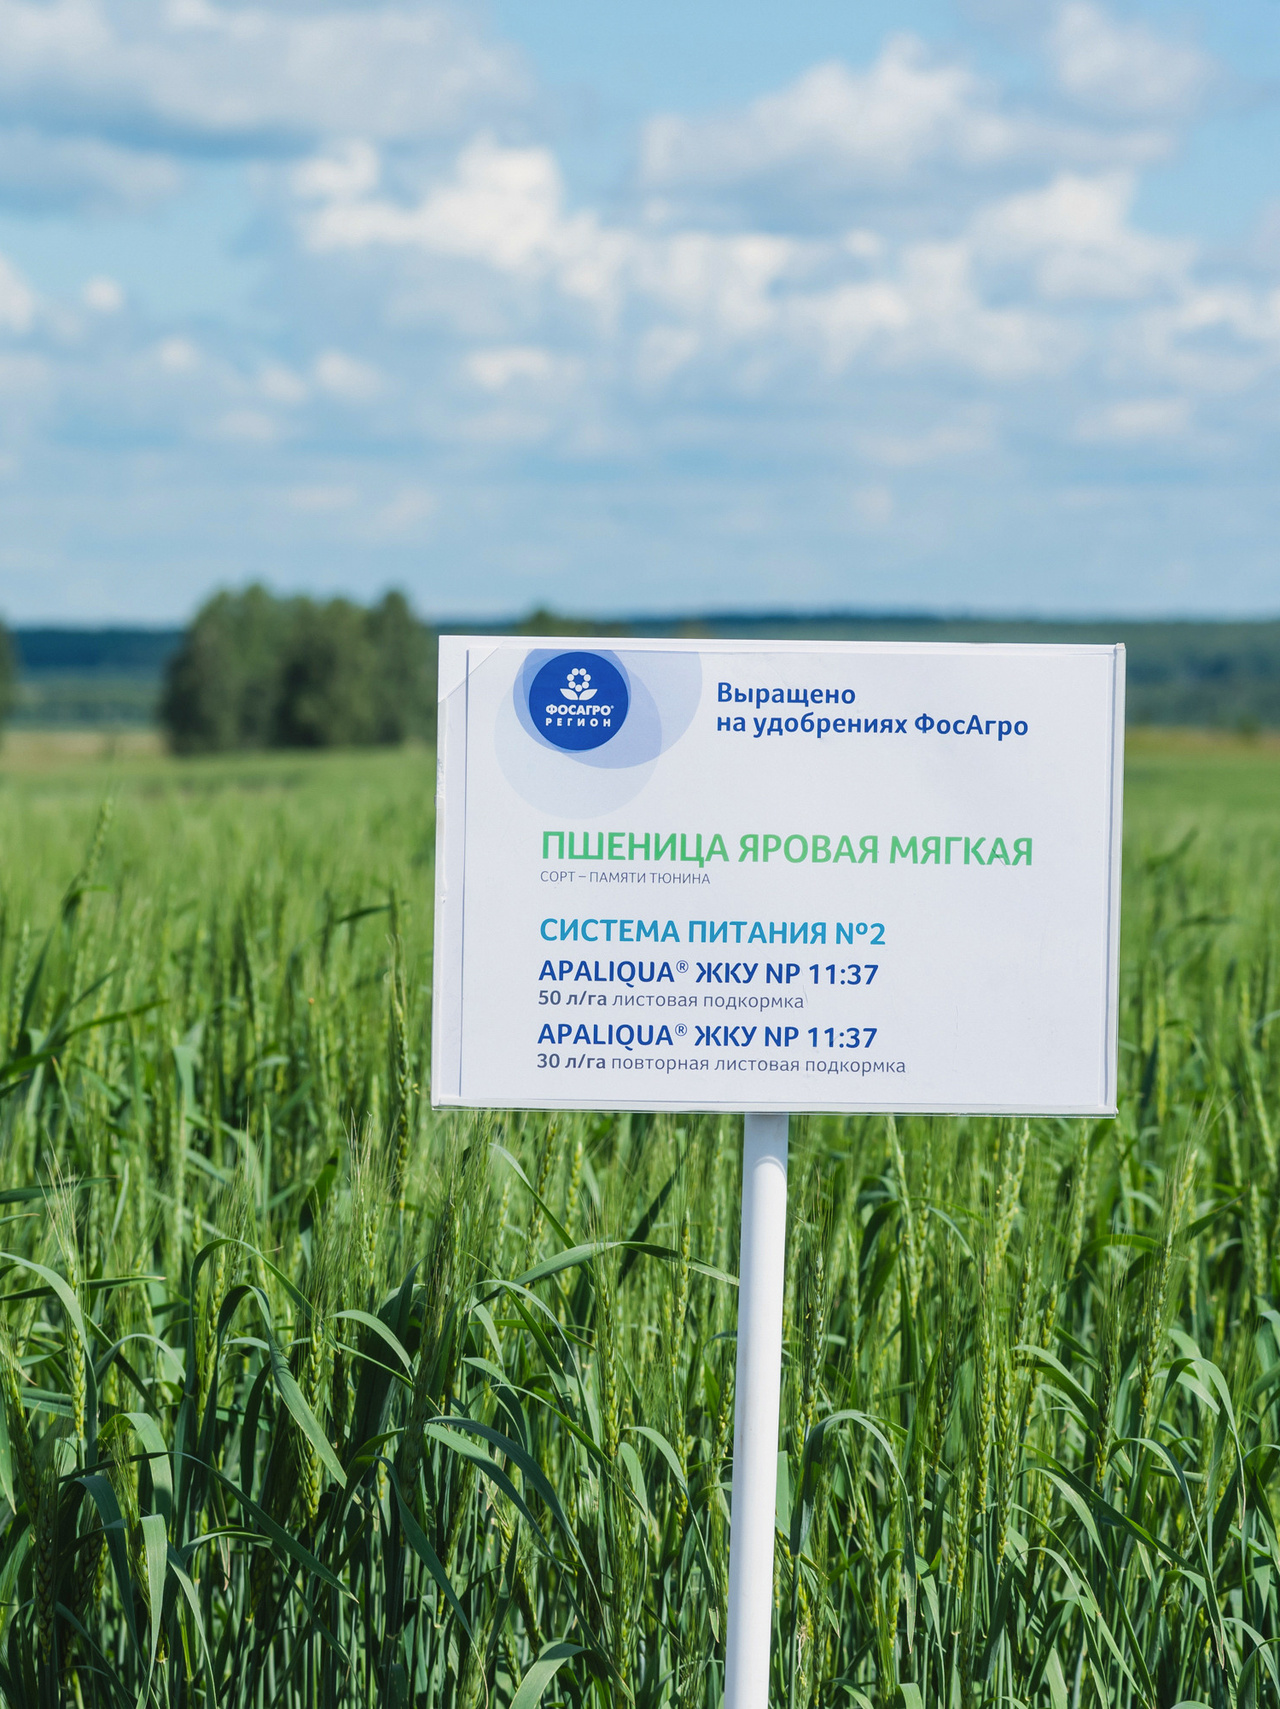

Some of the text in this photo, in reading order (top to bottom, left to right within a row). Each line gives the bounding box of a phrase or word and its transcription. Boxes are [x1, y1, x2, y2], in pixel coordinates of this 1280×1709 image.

[718, 682, 855, 708] Выращено
[545, 717, 611, 727] РЕГИОН
[717, 712, 1028, 741] на удобрениях ФосАгро
[543, 831, 1032, 868] ПШЕНИЦА ЯРОВАЯ МЯГКАЯ
[541, 871, 575, 882] СОРТ
[590, 872, 645, 883] ПАМЯТИ
[650, 873, 710, 884] ТЮНИНА
[540, 918, 680, 942] СИСТЕМА
[689, 921, 826, 944] ПИТАНИЯ
[696, 962, 758, 983] ЖКУ
[766, 963, 800, 984] NP
[809, 964, 878, 985] 11:37
[539, 990, 803, 1012] 50 л/га листовая подкормка
[695, 1026, 757, 1047] ЖКУ
[765, 1026, 799, 1047] NP
[808, 1027, 877, 1048] 11:37
[537, 1053, 905, 1076] 30 л/га повторная листовая подкормка
